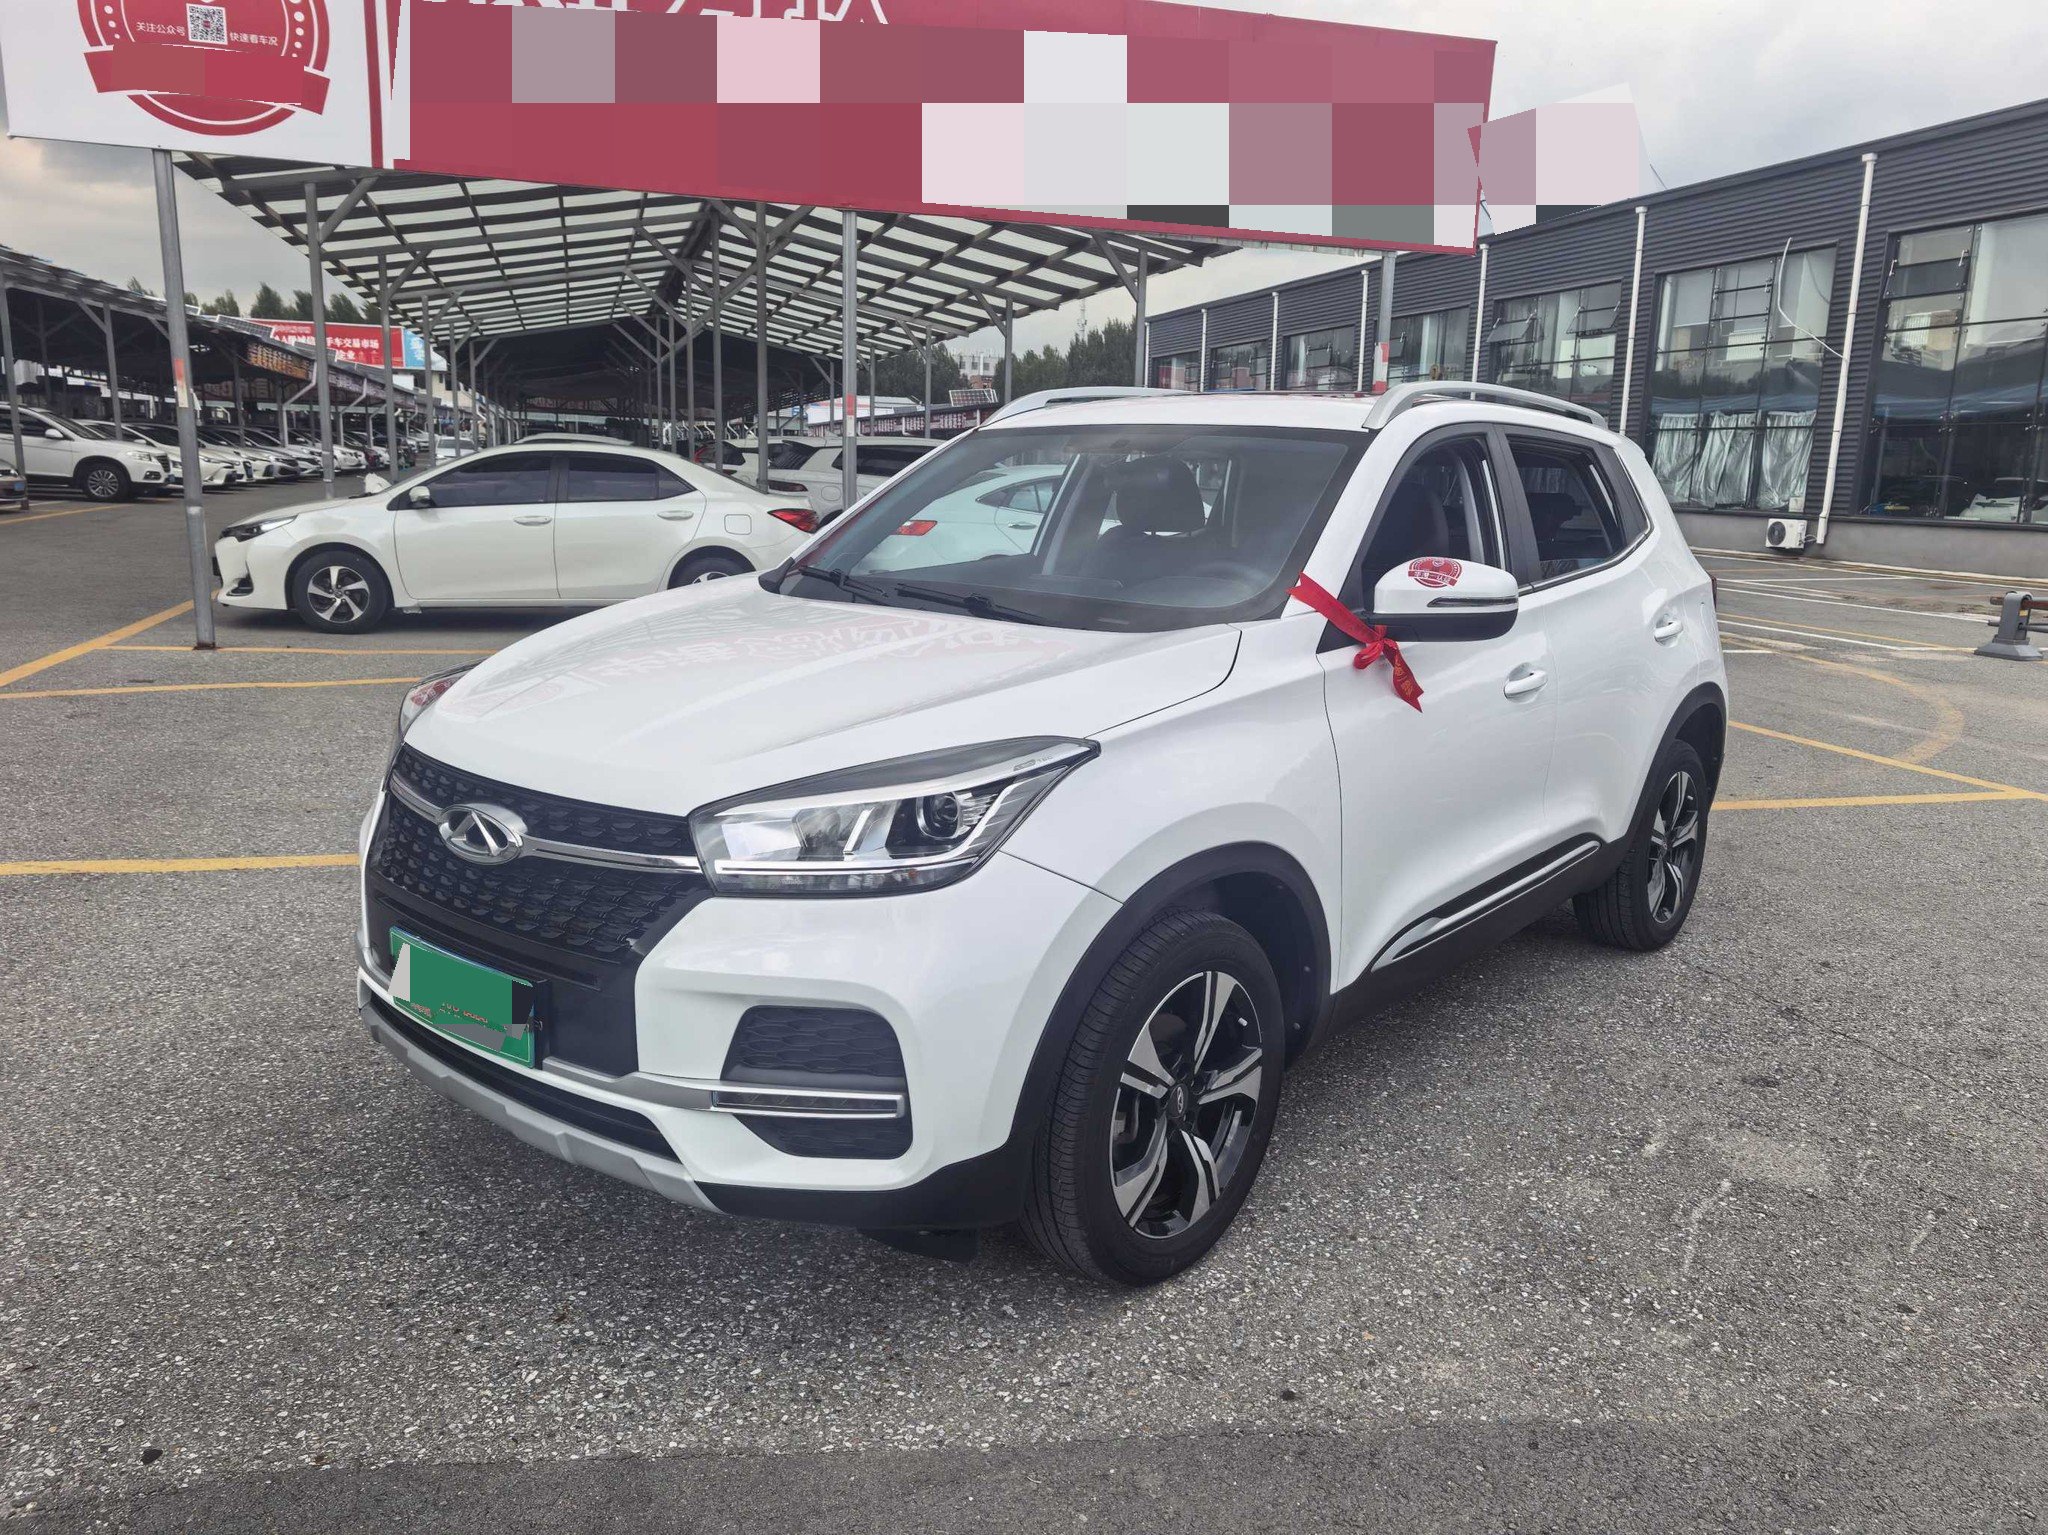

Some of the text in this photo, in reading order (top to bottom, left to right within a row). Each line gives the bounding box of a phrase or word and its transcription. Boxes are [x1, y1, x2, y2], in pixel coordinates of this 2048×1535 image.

[136, 21, 186, 37] 关注公众号
[229, 31, 279, 46] 快速看车况
